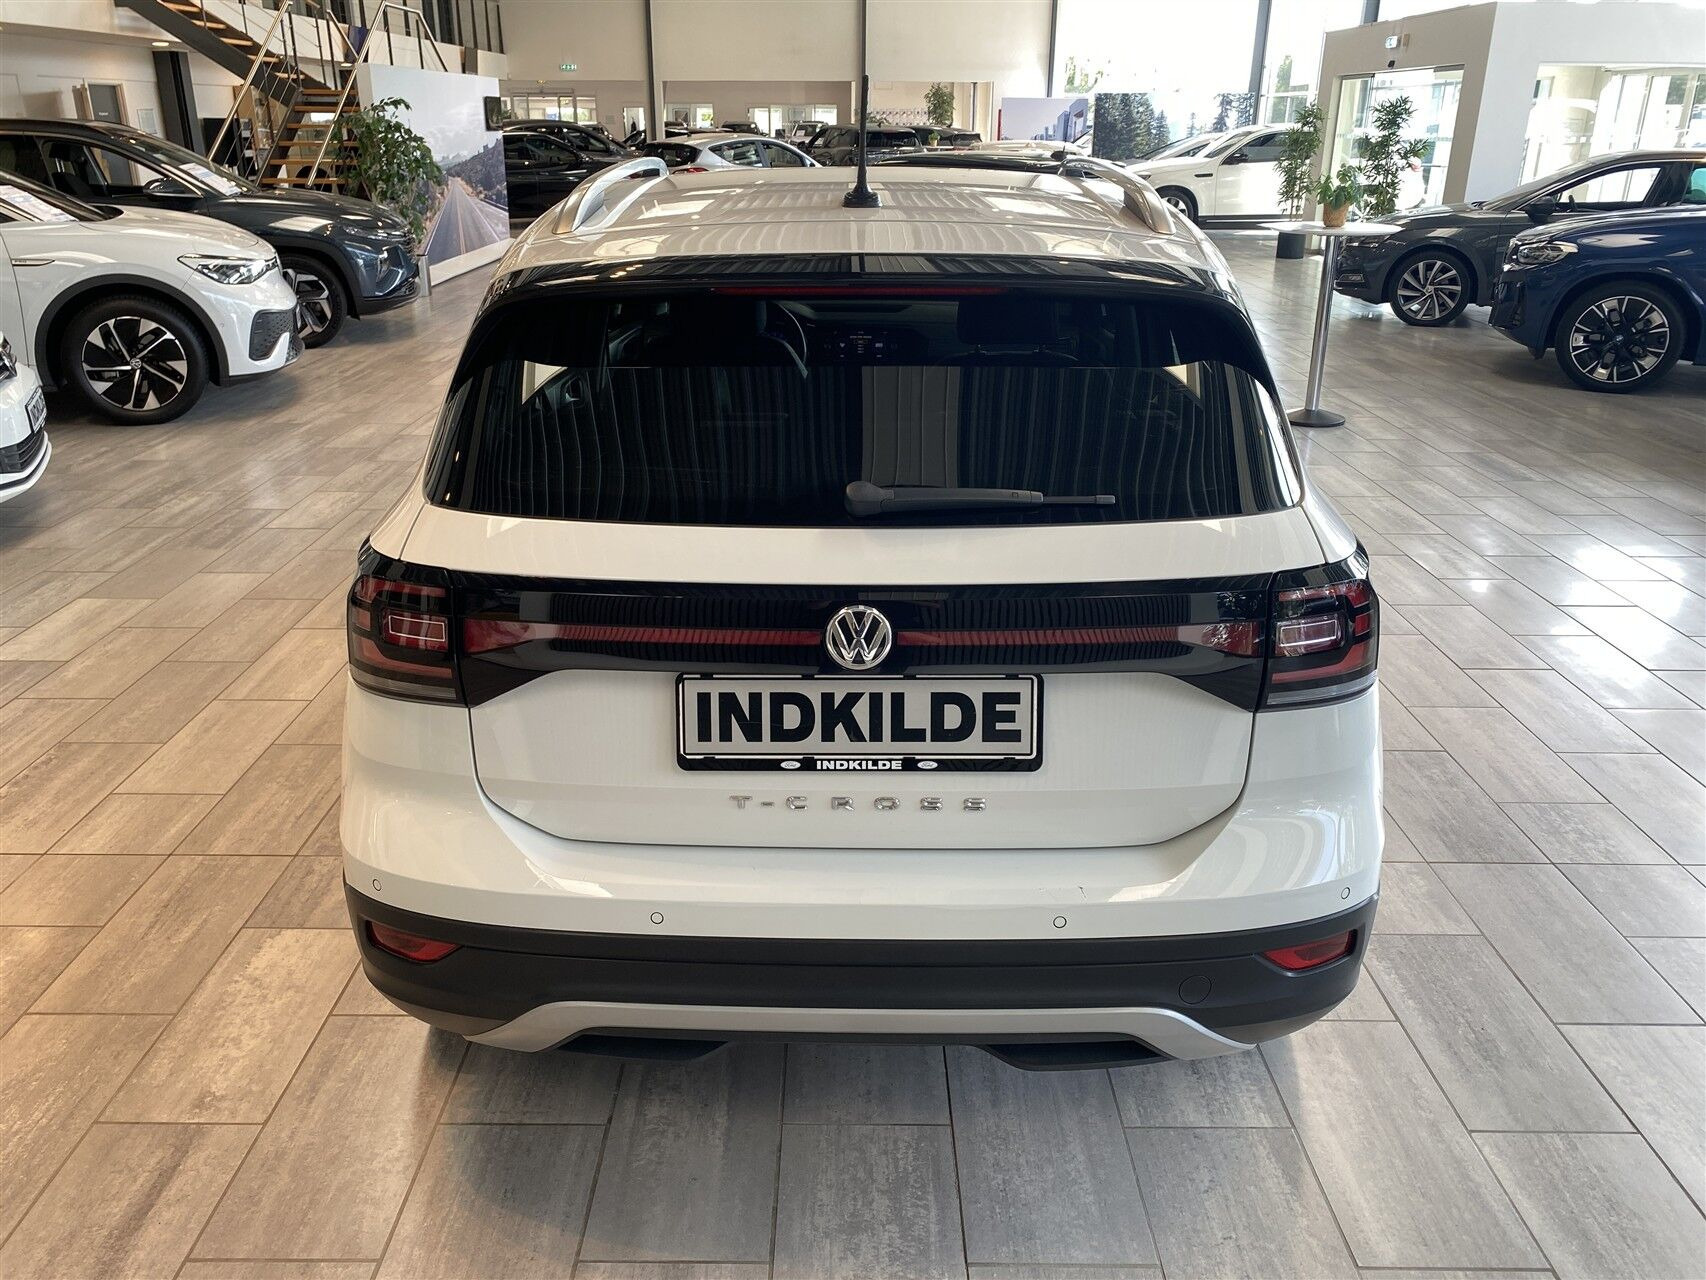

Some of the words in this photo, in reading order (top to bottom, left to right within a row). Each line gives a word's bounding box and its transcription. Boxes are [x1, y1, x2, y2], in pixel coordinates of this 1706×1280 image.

[696, 692, 1022, 743] INDKILDE
[816, 760, 903, 770] INDKILDE
[729, 795, 987, 812] T-CROSS
